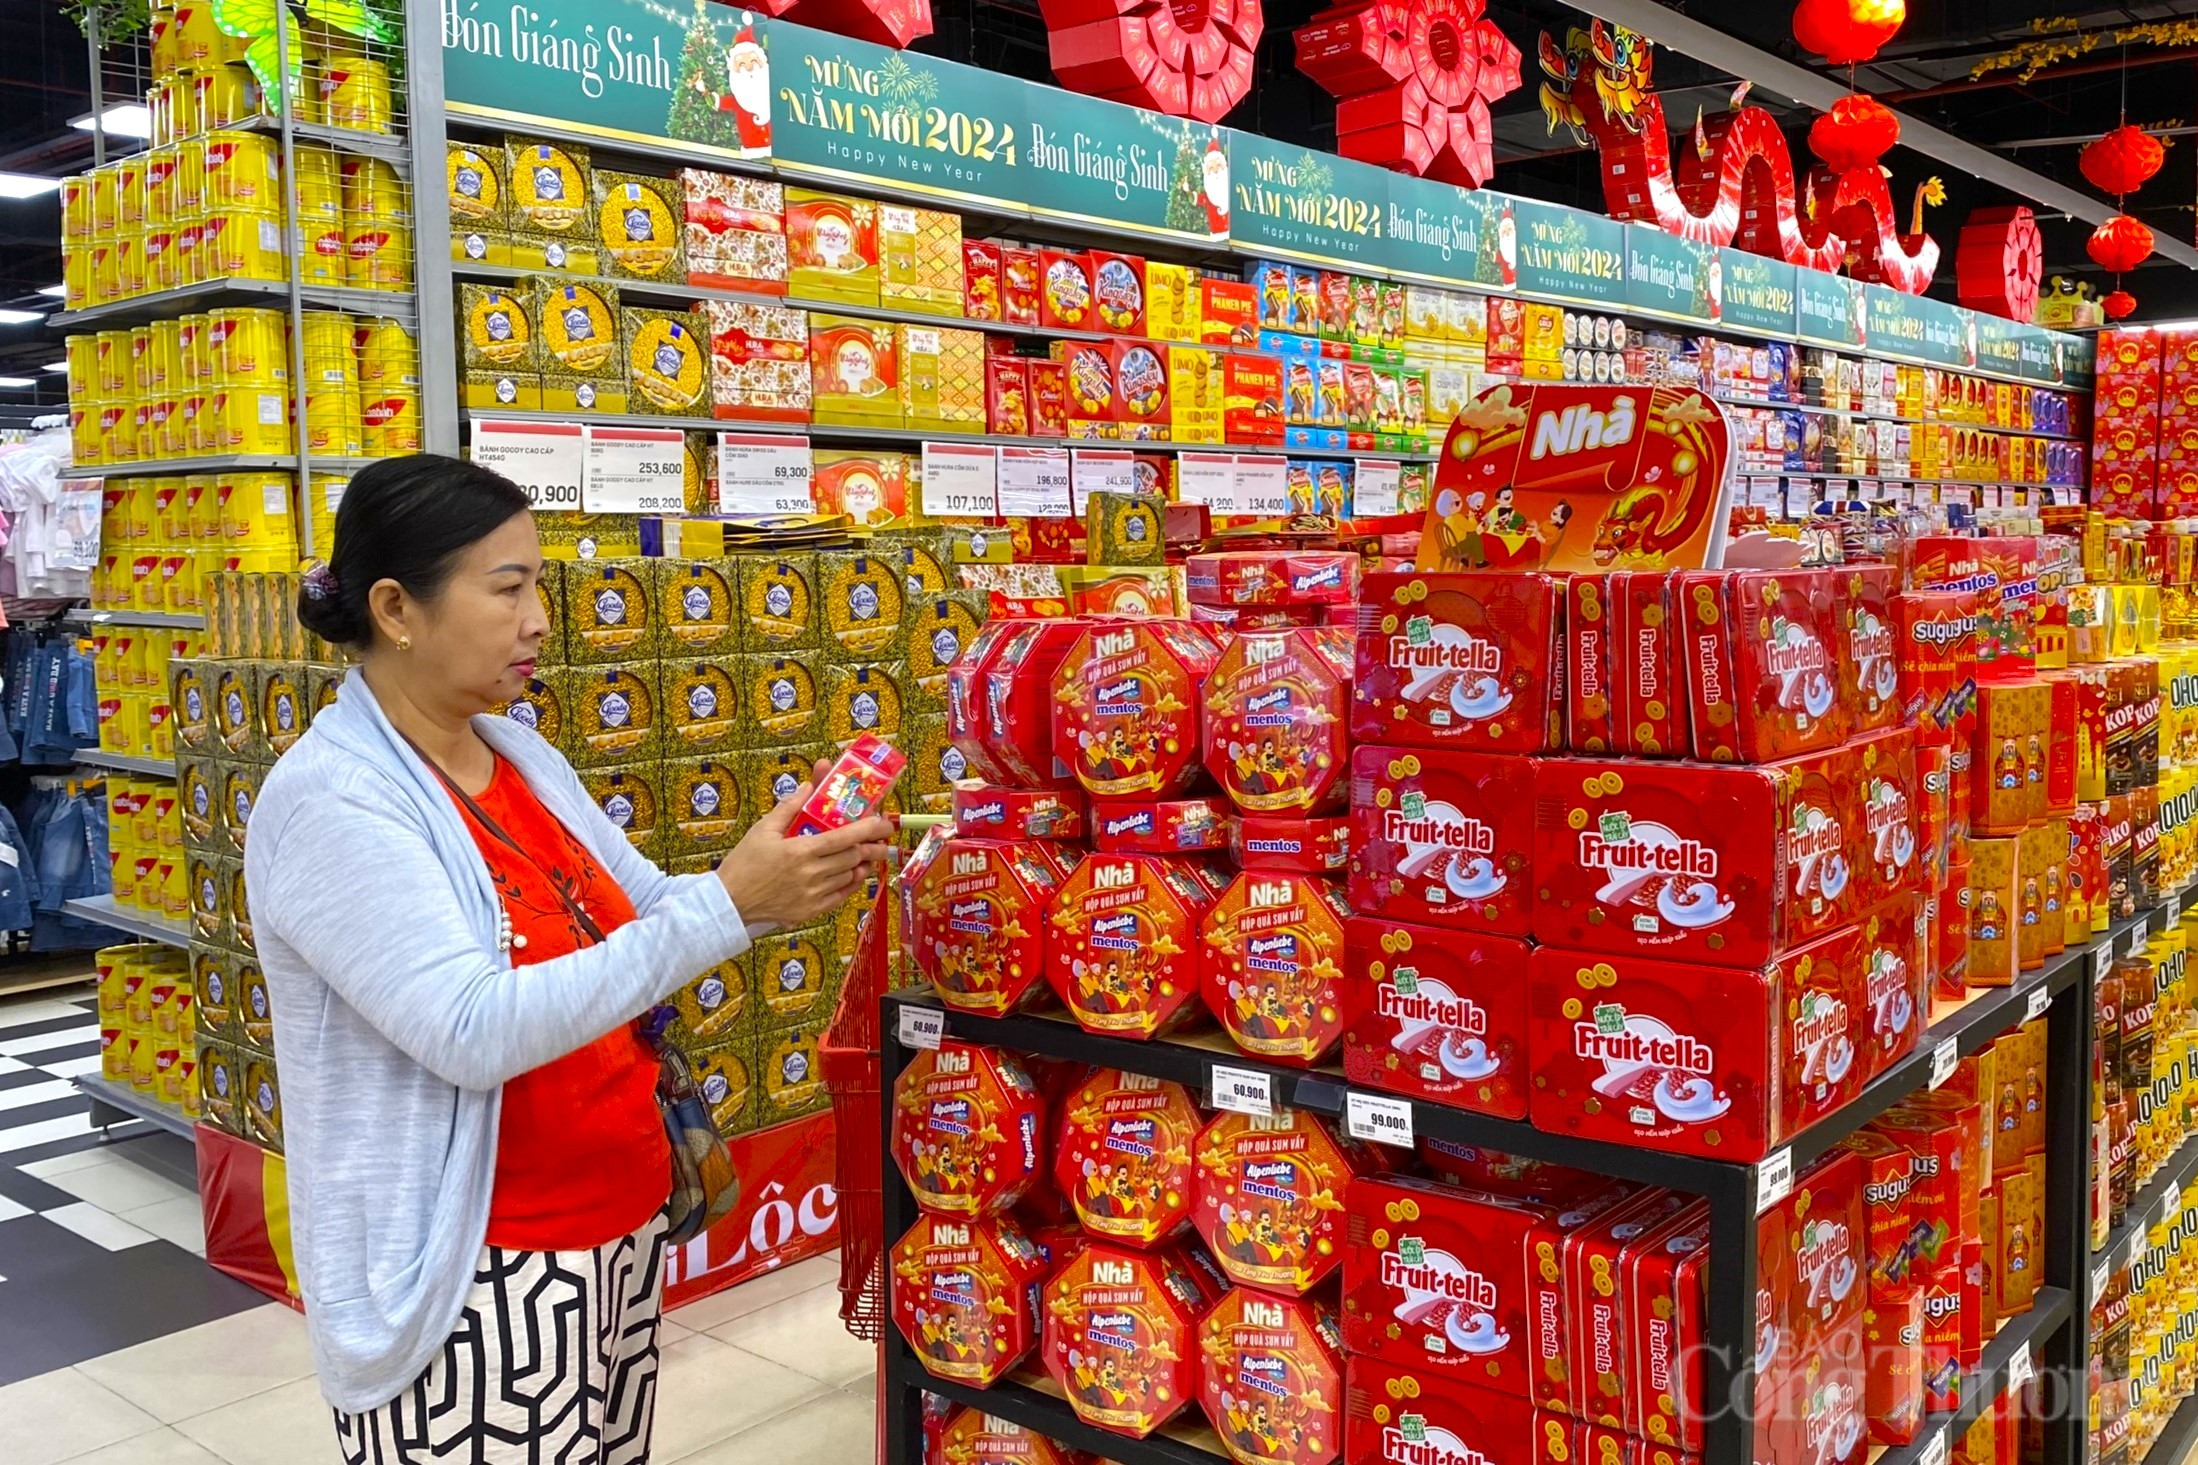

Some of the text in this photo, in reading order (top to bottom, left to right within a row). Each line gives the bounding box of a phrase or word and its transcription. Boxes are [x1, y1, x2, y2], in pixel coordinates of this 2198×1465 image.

[511, 4, 603, 98] Giáng
[607, 25, 672, 90] Sinh
[805, 53, 879, 97] MỪNG
[780, 86, 855, 134] NĂM
[925, 106, 1016, 166] 2024
[827, 140, 983, 182] Happy New Year
[1026, 123, 1169, 200] Đón Giáng Sinh
[1251, 155, 1298, 188] MỪNG
[1236, 182, 1281, 219] NĂM
[1324, 193, 1382, 239] 2024
[626, 213, 652, 232] Goody
[1387, 202, 1477, 261] Đón Giáng Sinh
[1262, 225, 1360, 252] Happy New Year
[1582, 249, 1622, 281] 2024
[1538, 275, 1607, 295] Happy New Year
[1650, 254, 1675, 299] Giáng
[1675, 260, 1694, 293] Sinh
[1050, 278, 1085, 307] Kingsley
[1100, 279, 1137, 310] Kingsley
[1211, 297, 1252, 312] PHANER PIE
[1073, 359, 1108, 400] Kingsley
[1123, 365, 1159, 395] Kingsley
[1234, 372, 1276, 386] PHANER PIE
[1530, 394, 1636, 461] Nhà
[639, 462, 682, 475] 253,600
[775, 466, 808, 479] 69,300
[1037, 475, 1068, 487] 196,800
[639, 497, 682, 510] 208,200
[946, 496, 993, 512] 107,100
[1248, 498, 1284, 512] 134,400
[1241, 563, 1265, 578] Nhà
[1950, 558, 1979, 575] Nhà
[1294, 566, 1340, 590] Alpenliebe
[598, 600, 624, 614] Goody
[686, 595, 710, 610] Goody
[768, 590, 792, 606] Goody
[851, 591, 878, 609] Goody
[1095, 627, 1136, 656] Nhà
[1850, 625, 1892, 664] Fruit-tella
[1390, 636, 1500, 674] Fruit-tella
[1579, 628, 1598, 699] Fruit-tella
[1766, 631, 1825, 676] Fruit-tella
[1102, 664, 1117, 677] QUÀ
[1117, 658, 1132, 672] SUM
[771, 686, 796, 701] Goody
[1098, 679, 1137, 701] Alpenliebe
[1247, 687, 1288, 712] Alpenliebe
[601, 703, 629, 718] Goody
[691, 694, 716, 709] Goody
[851, 702, 879, 718] Goody
[1096, 702, 1142, 715] mentos
[1246, 711, 1293, 726] mentos
[694, 790, 719, 806] Goody
[1033, 797, 1058, 813] Nhà
[605, 804, 634, 819] Goody
[962, 802, 1004, 822] Alpenliebe
[1107, 812, 1149, 835] Alpenliebe
[1384, 809, 1494, 853] Fruit-tella
[1248, 837, 1300, 852] mentos
[1787, 816, 1842, 866] Fruit-tella
[953, 850, 987, 875] Nhà
[1579, 830, 1719, 879] Fruit-tella
[1095, 861, 1135, 889] Nhà
[1085, 892, 1130, 912] HỘP QUÀ SUM
[1250, 880, 1293, 908] Nhà
[951, 919, 991, 934] mentos
[1094, 914, 1134, 935] Alpenliebe
[1092, 936, 1138, 950] mentos
[1251, 935, 1293, 955] Alpenliebe
[781, 968, 805, 981] Goody
[1248, 956, 1298, 973] mentos
[1377, 981, 1487, 1036] Fruit-tella
[1794, 998, 1849, 1057] Fruit-tella
[1574, 1021, 1714, 1075] Fruit-tella
[783, 1062, 808, 1076] Goody
[936, 1052, 970, 1073] Nhà
[929, 1117, 969, 1135] mentos
[1111, 1118, 1152, 1138] Alpenliebe
[1106, 1137, 1152, 1156] mentos
[1237, 1138, 1289, 1155] HỘP QUÀ SUM
[1246, 1161, 1292, 1183] Alpenliebe
[1243, 1180, 1295, 1201] mentos
[934, 1224, 969, 1245] Nhà
[1797, 1219, 1850, 1283] Fruit-tella
[1093, 1261, 1134, 1285] Nhà
[1381, 1249, 1497, 1310] Fruit-tella
[931, 1286, 974, 1306] mentos
[1091, 1312, 1133, 1330] Alpenliebe
[1243, 1301, 1284, 1327] Nhà
[1541, 1291, 1557, 1360] Fruit-tella
[1089, 1328, 1136, 1351] mentos
[1243, 1355, 1283, 1372] Alpenliebe
[1240, 1373, 1287, 1398] mentos
